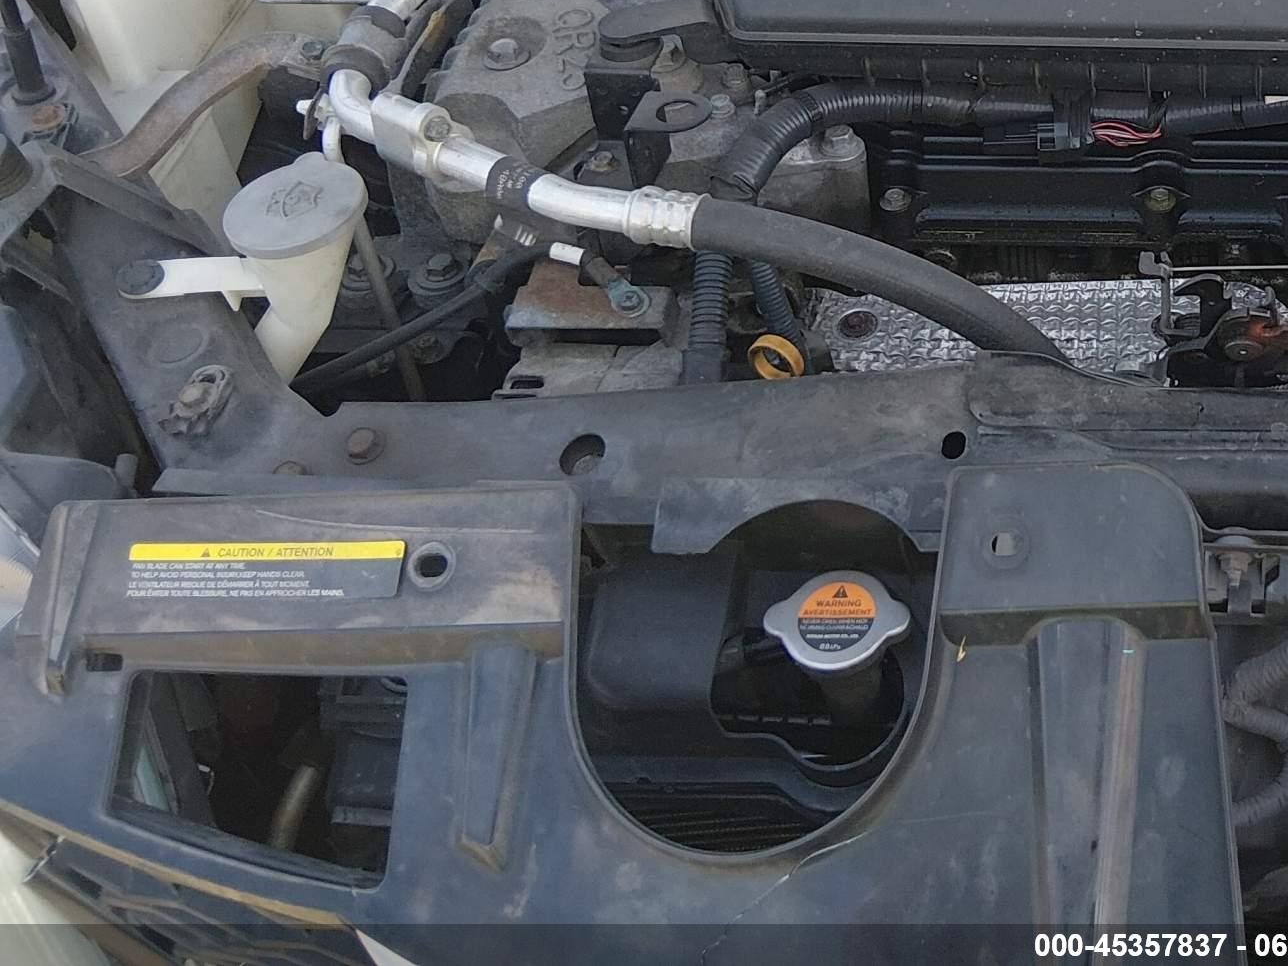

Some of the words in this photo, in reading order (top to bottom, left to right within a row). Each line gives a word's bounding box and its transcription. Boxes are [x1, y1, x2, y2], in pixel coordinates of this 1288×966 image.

[217, 547, 265, 557] CAUTION
[276, 547, 334, 557] ATTENTION
[816, 599, 862, 607] WARNING
[803, 608, 872, 616] AVERTISSEMENT
